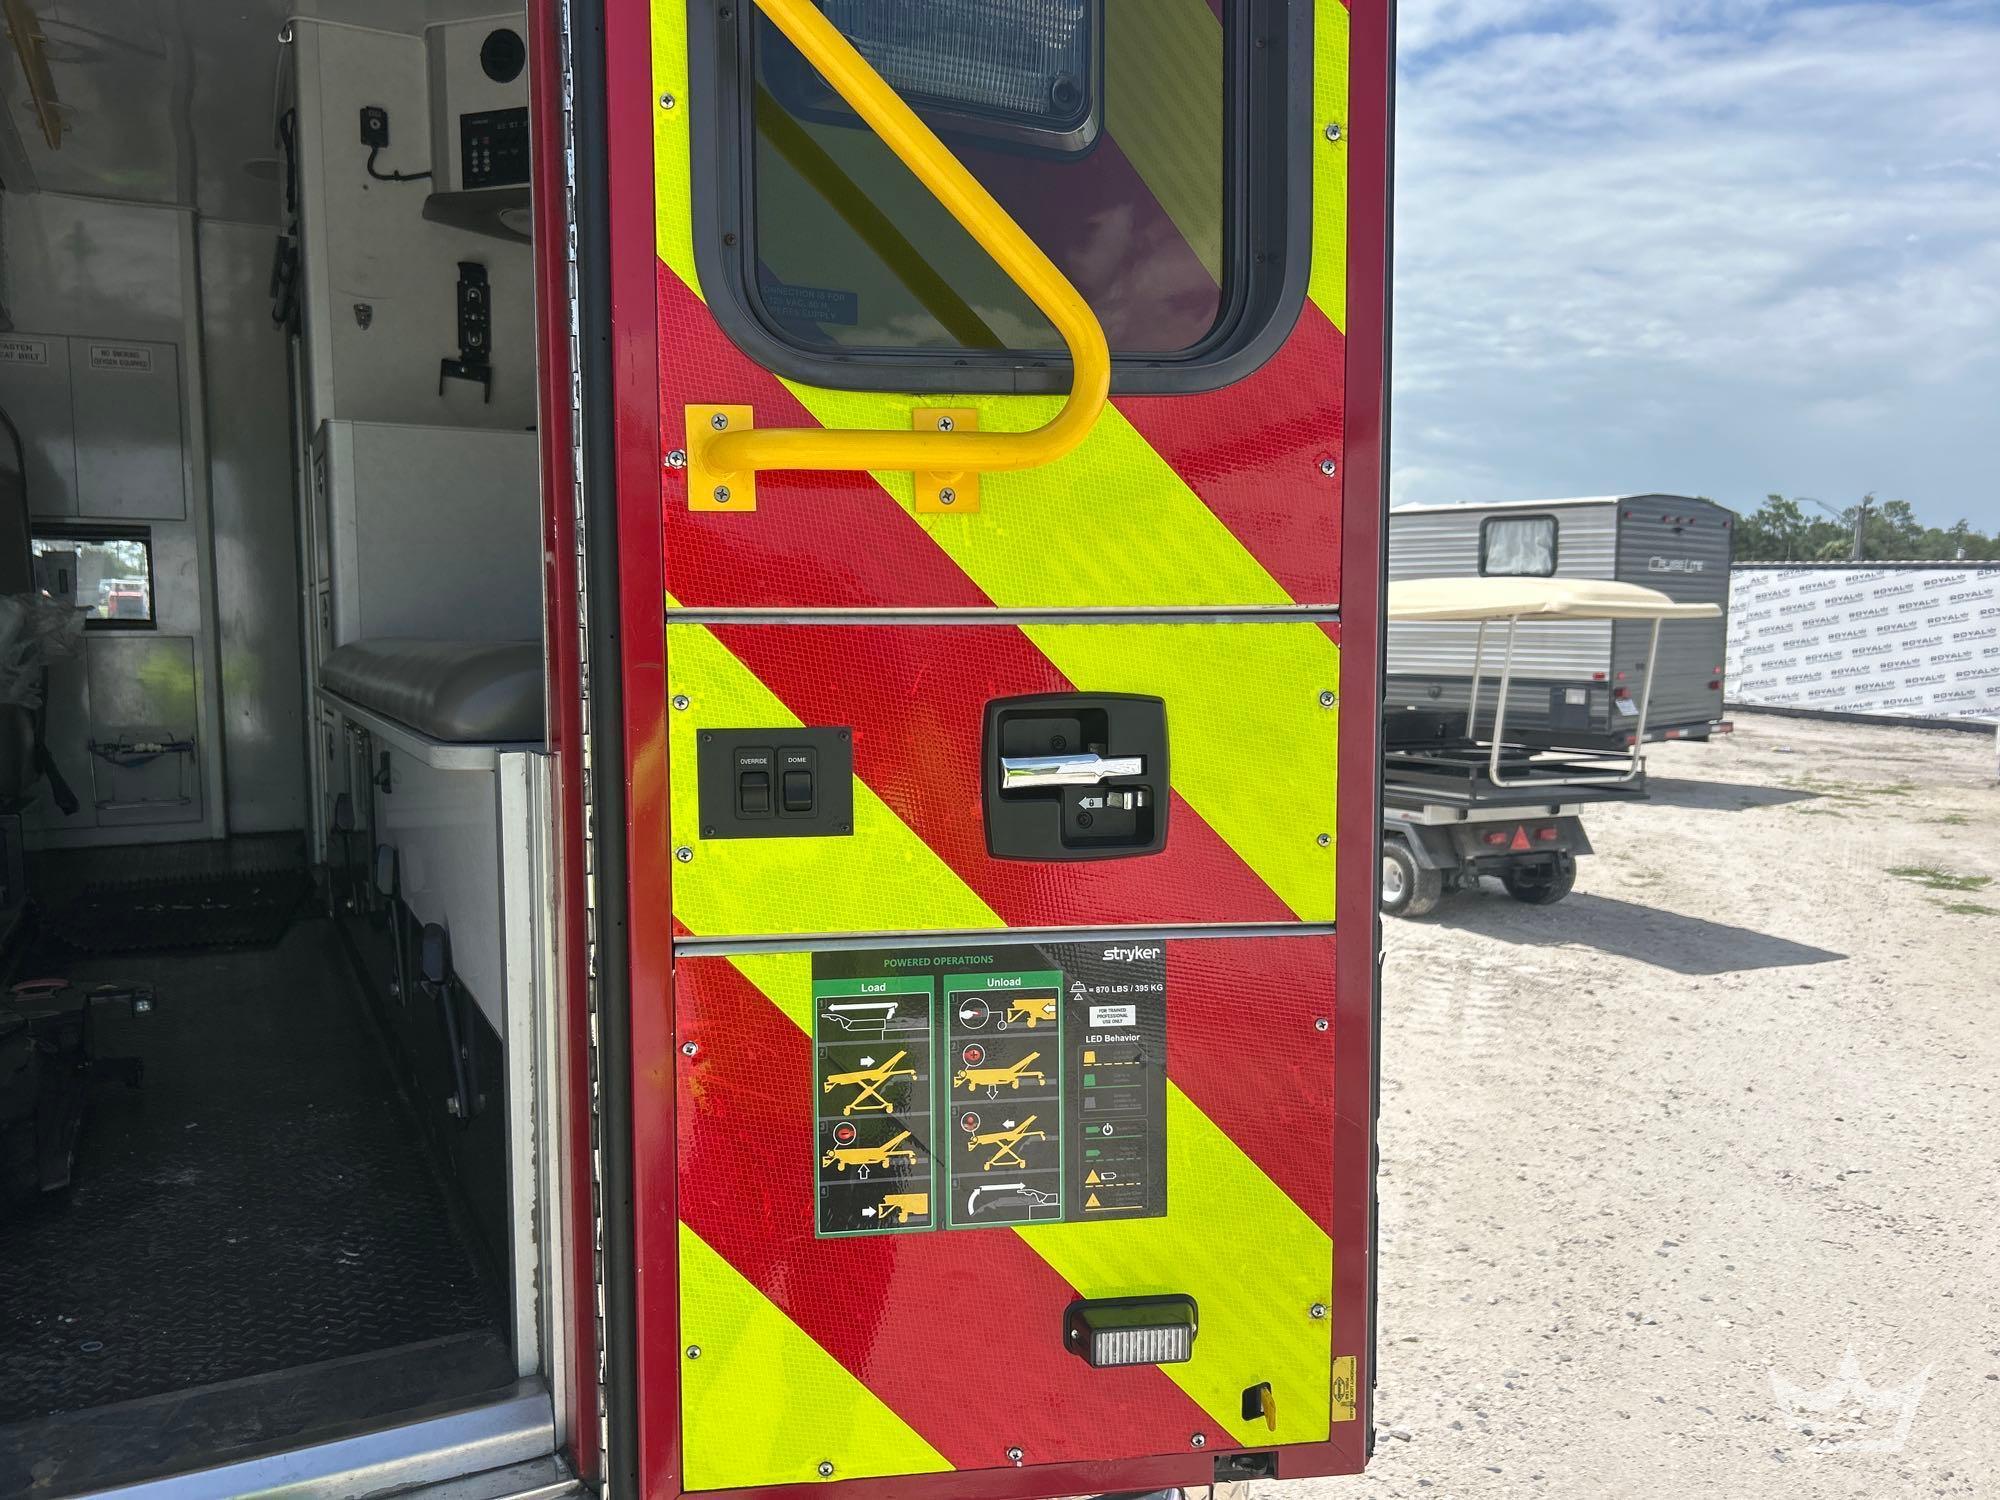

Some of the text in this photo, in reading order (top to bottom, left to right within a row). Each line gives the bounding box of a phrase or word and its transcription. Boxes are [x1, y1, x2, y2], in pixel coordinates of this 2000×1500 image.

[1102, 946, 1160, 962] stryker
[884, 955, 994, 968] POWERED OPERATIONS
[861, 982, 886, 992] Load
[987, 977, 1022, 987] Unload
[1096, 986, 1109, 994] 870
[1135, 984, 1148, 992] 395
[1150, 984, 1164, 992] KG
[1086, 1034, 1140, 1043] LED Behavior
